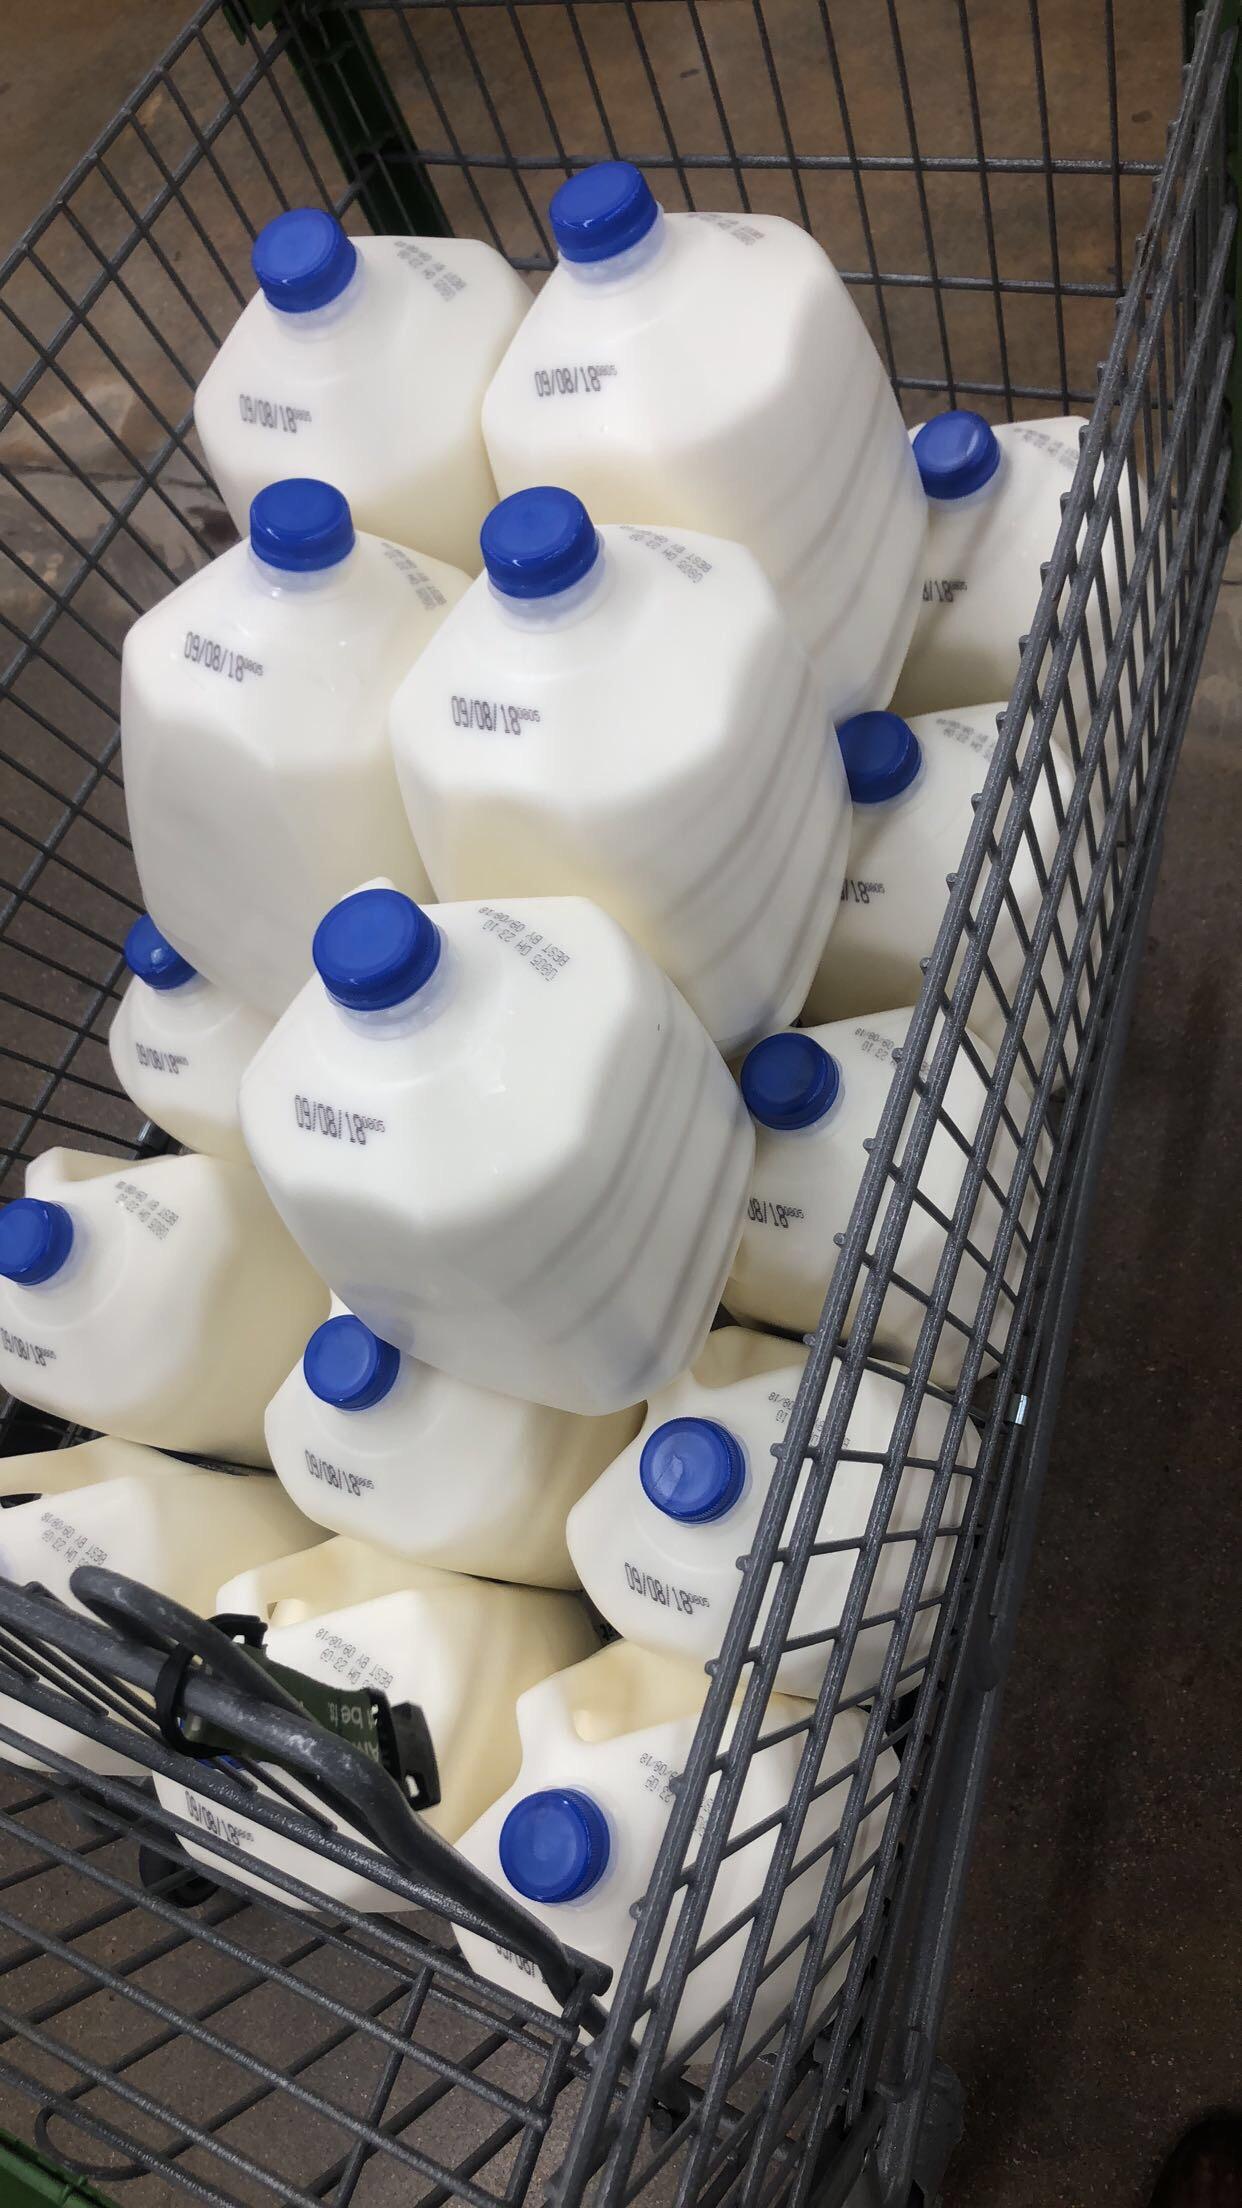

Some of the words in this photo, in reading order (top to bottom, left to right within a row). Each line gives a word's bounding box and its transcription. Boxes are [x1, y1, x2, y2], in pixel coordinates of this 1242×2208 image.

[535, 365, 601, 397] 09/08/18
[184, 631, 244, 682] 09/08/18
[451, 695, 521, 735] 09/08/18
[295, 1094, 366, 1145] 09/08/18
[305, 1449, 361, 1497] 09/08/18
[625, 1562, 693, 1615] 09/08/18
